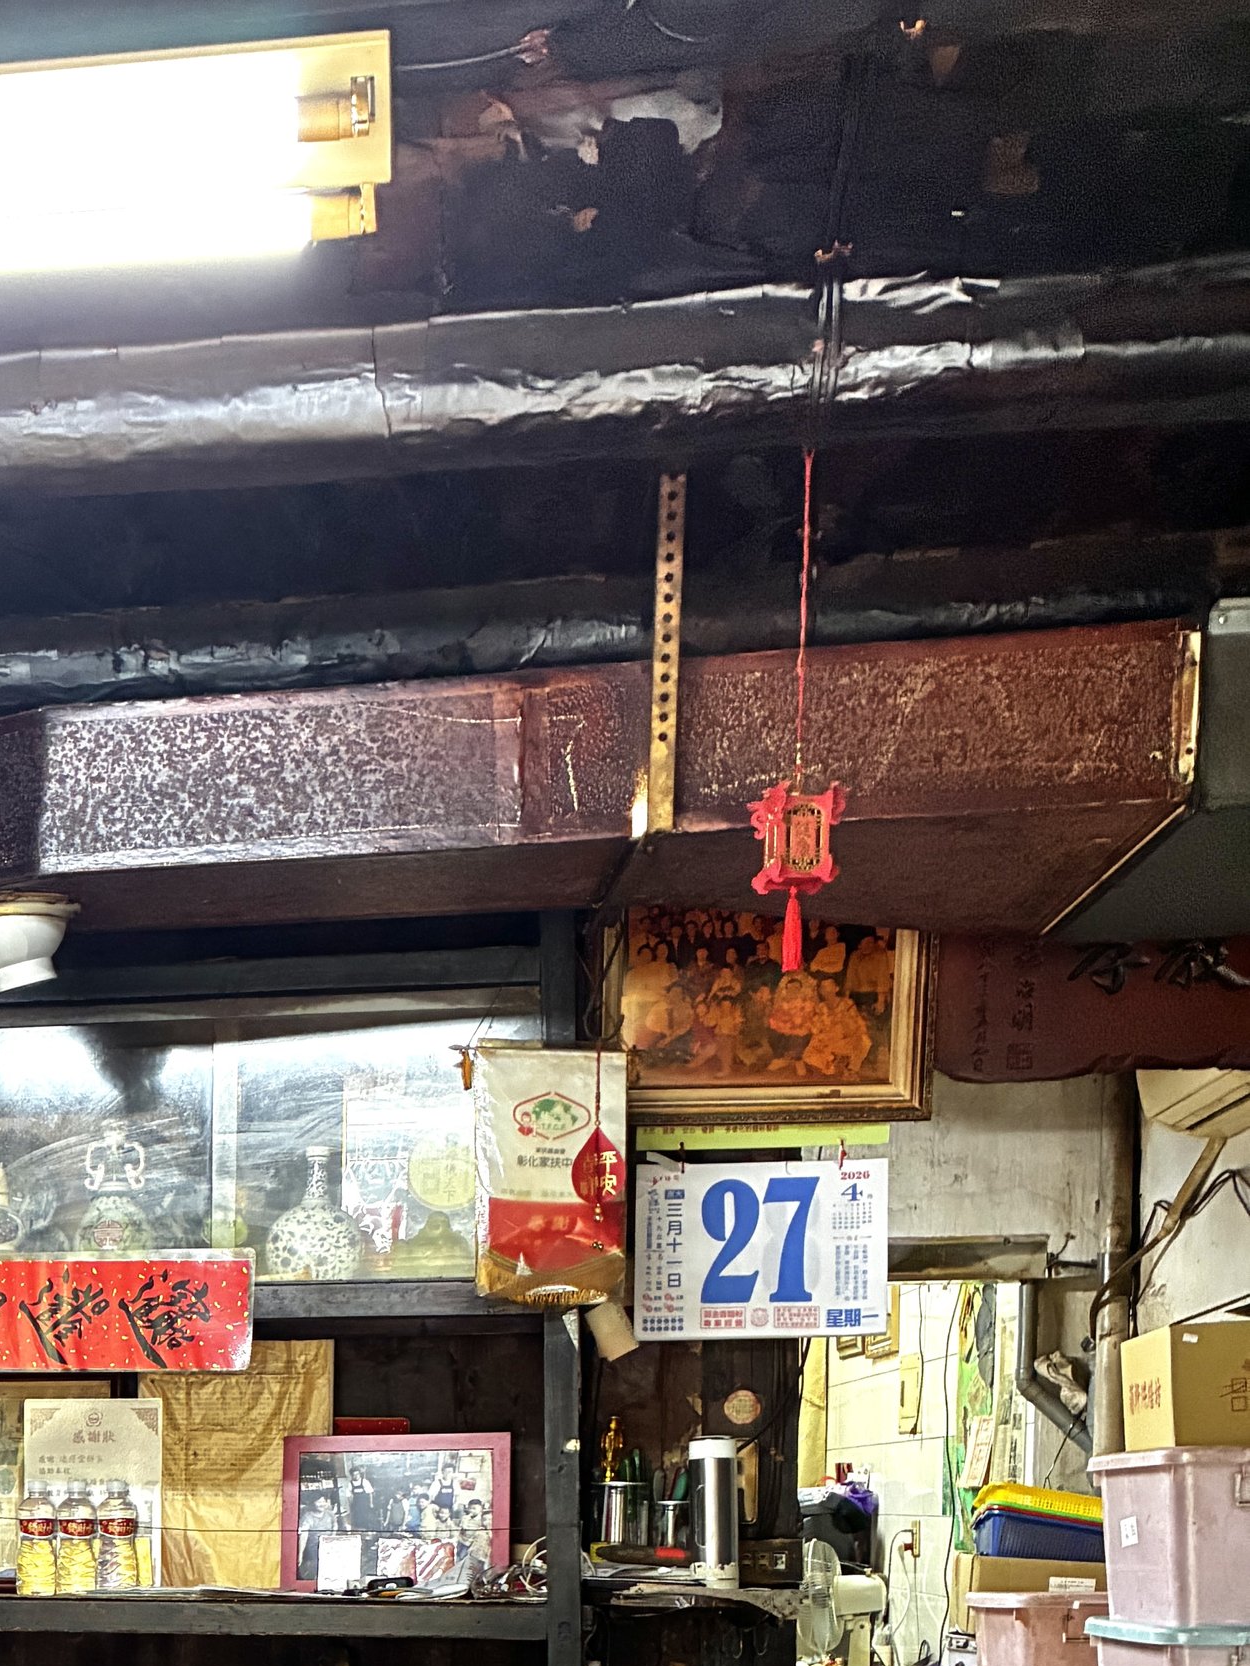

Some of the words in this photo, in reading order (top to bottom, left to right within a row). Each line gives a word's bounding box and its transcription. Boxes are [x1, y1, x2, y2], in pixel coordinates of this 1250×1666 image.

[599, 1150, 618, 1196] 平安
[841, 1171, 870, 1180] 2026
[841, 1183, 863, 1202] 4
[665, 1202, 684, 1288] 三月十一日
[700, 1176, 820, 1304] 27
[826, 1308, 879, 1328] 星期一
